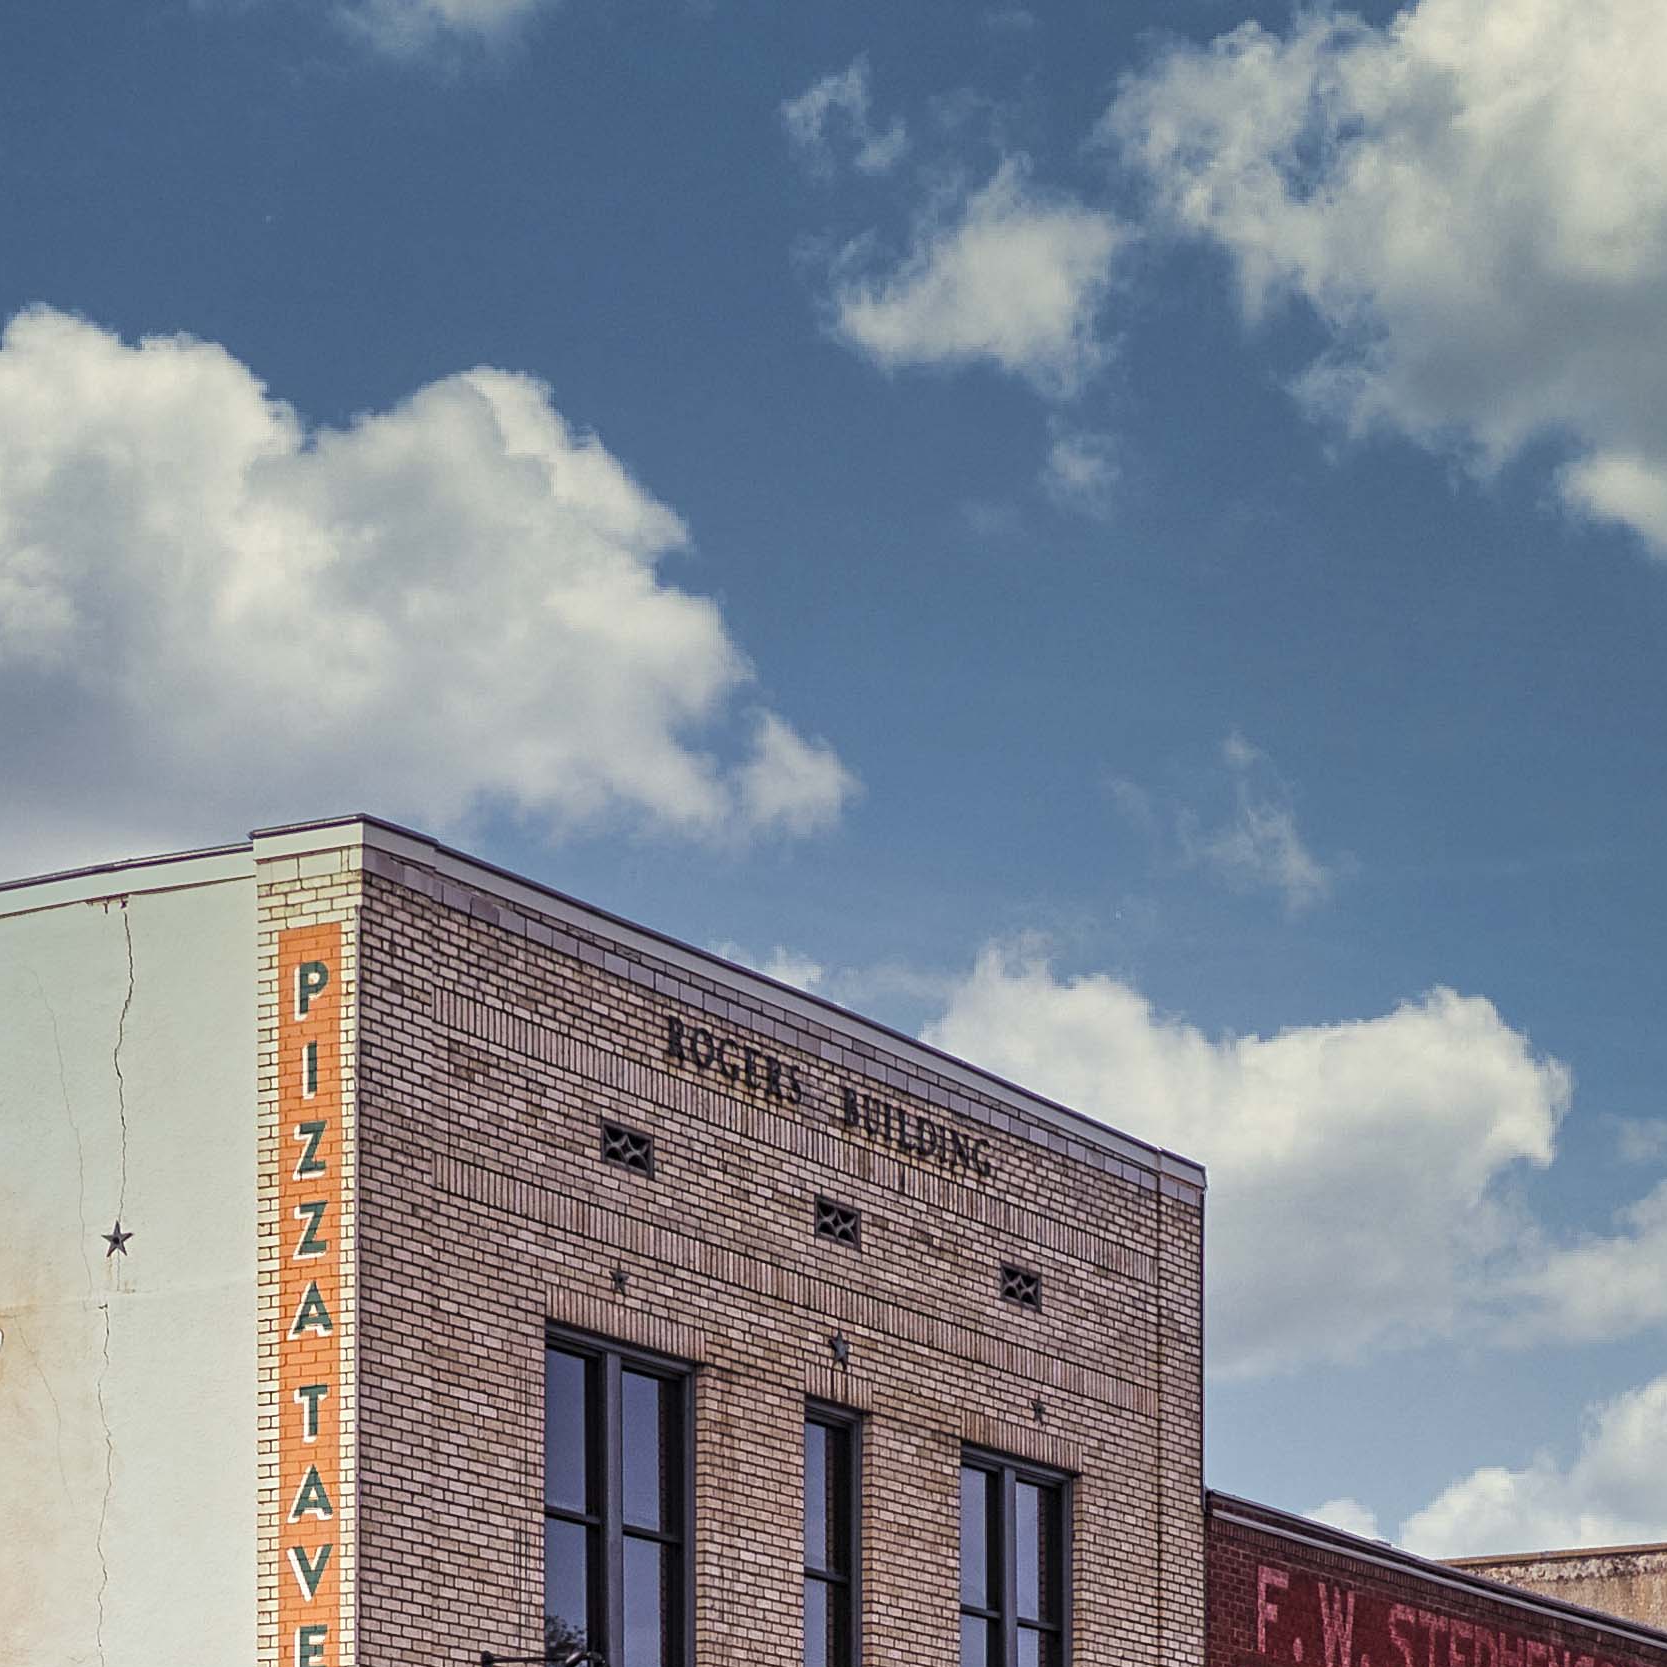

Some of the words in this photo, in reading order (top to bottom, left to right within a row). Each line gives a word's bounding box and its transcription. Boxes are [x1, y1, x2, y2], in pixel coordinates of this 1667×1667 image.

[287, 959, 333, 1342] PIZZA
[665, 1014, 807, 1107] ROGERS
[841, 1084, 994, 1180] BUILDING
[1256, 1565, 1303, 1664] F.
